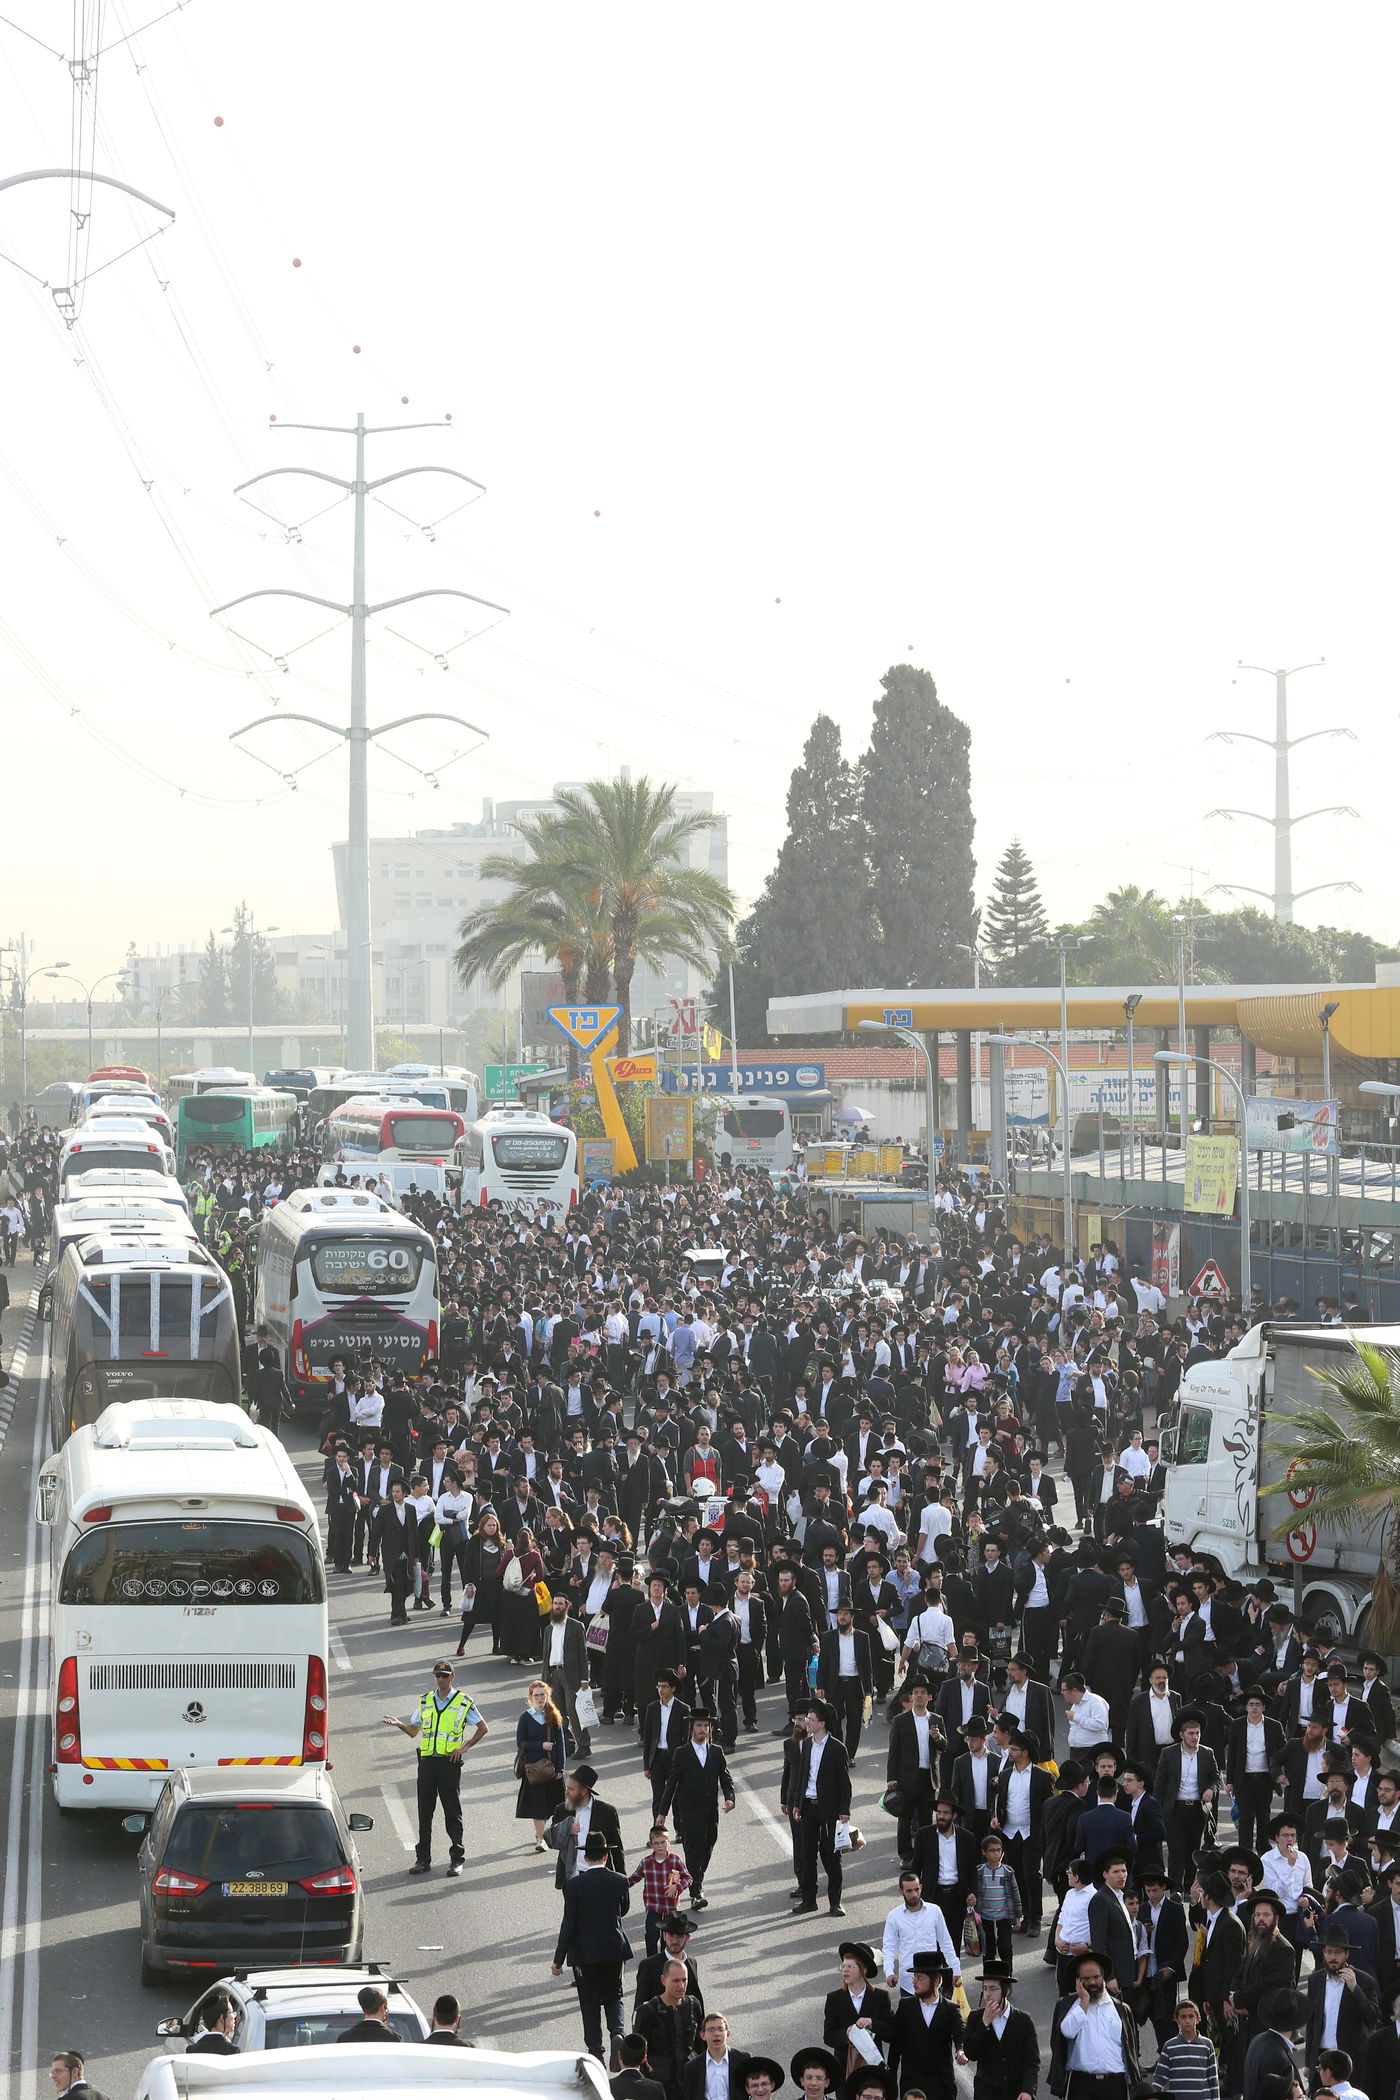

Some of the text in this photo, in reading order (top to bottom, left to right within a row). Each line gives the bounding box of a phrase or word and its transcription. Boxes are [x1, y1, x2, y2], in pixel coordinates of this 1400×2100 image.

[567, 1011, 599, 1030] פז
[883, 1009, 913, 1027] פז
[325, 1250, 366, 1259] מקומות
[367, 1249, 409, 1269] 60
[324, 1260, 366, 1269] ישיבה
[310, 1335, 421, 1348] מסיעי מוטי בע"מ
[1190, 1384, 1231, 1396] King Of The Road
[1222, 1518, 1237, 1529] 5236
